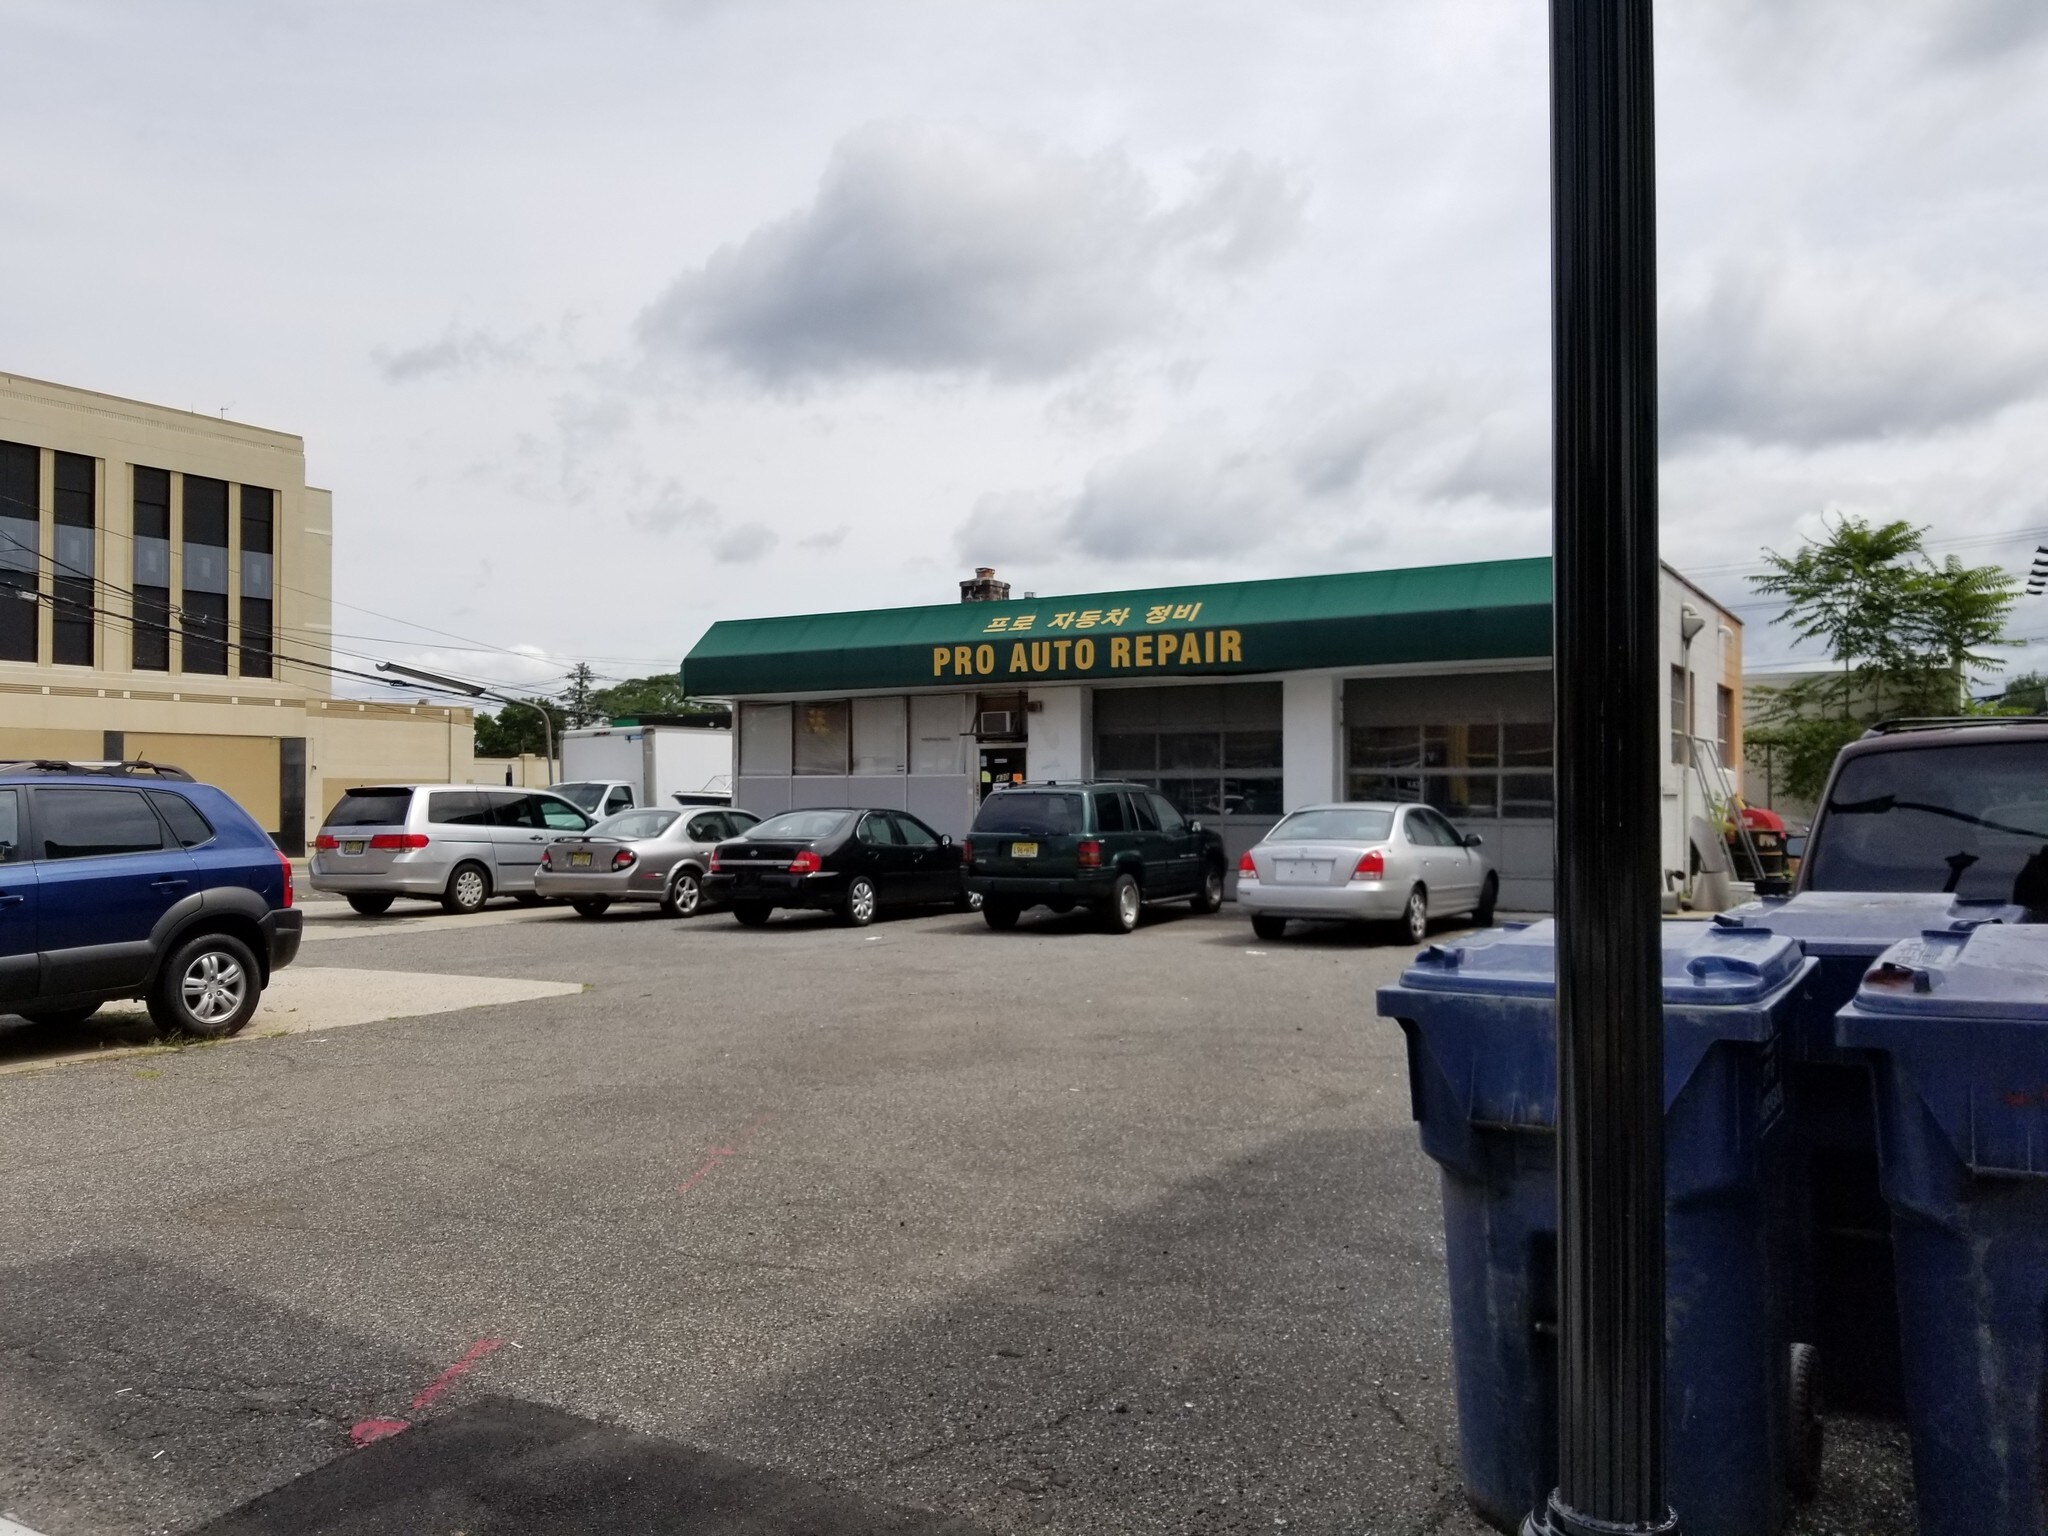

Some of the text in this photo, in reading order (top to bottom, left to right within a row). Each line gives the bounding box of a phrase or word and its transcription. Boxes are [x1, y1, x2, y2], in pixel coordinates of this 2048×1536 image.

[982, 602, 1204, 634] 프로 자동차 정비
[933, 630, 1244, 677] PRO AUTO REPAIR
